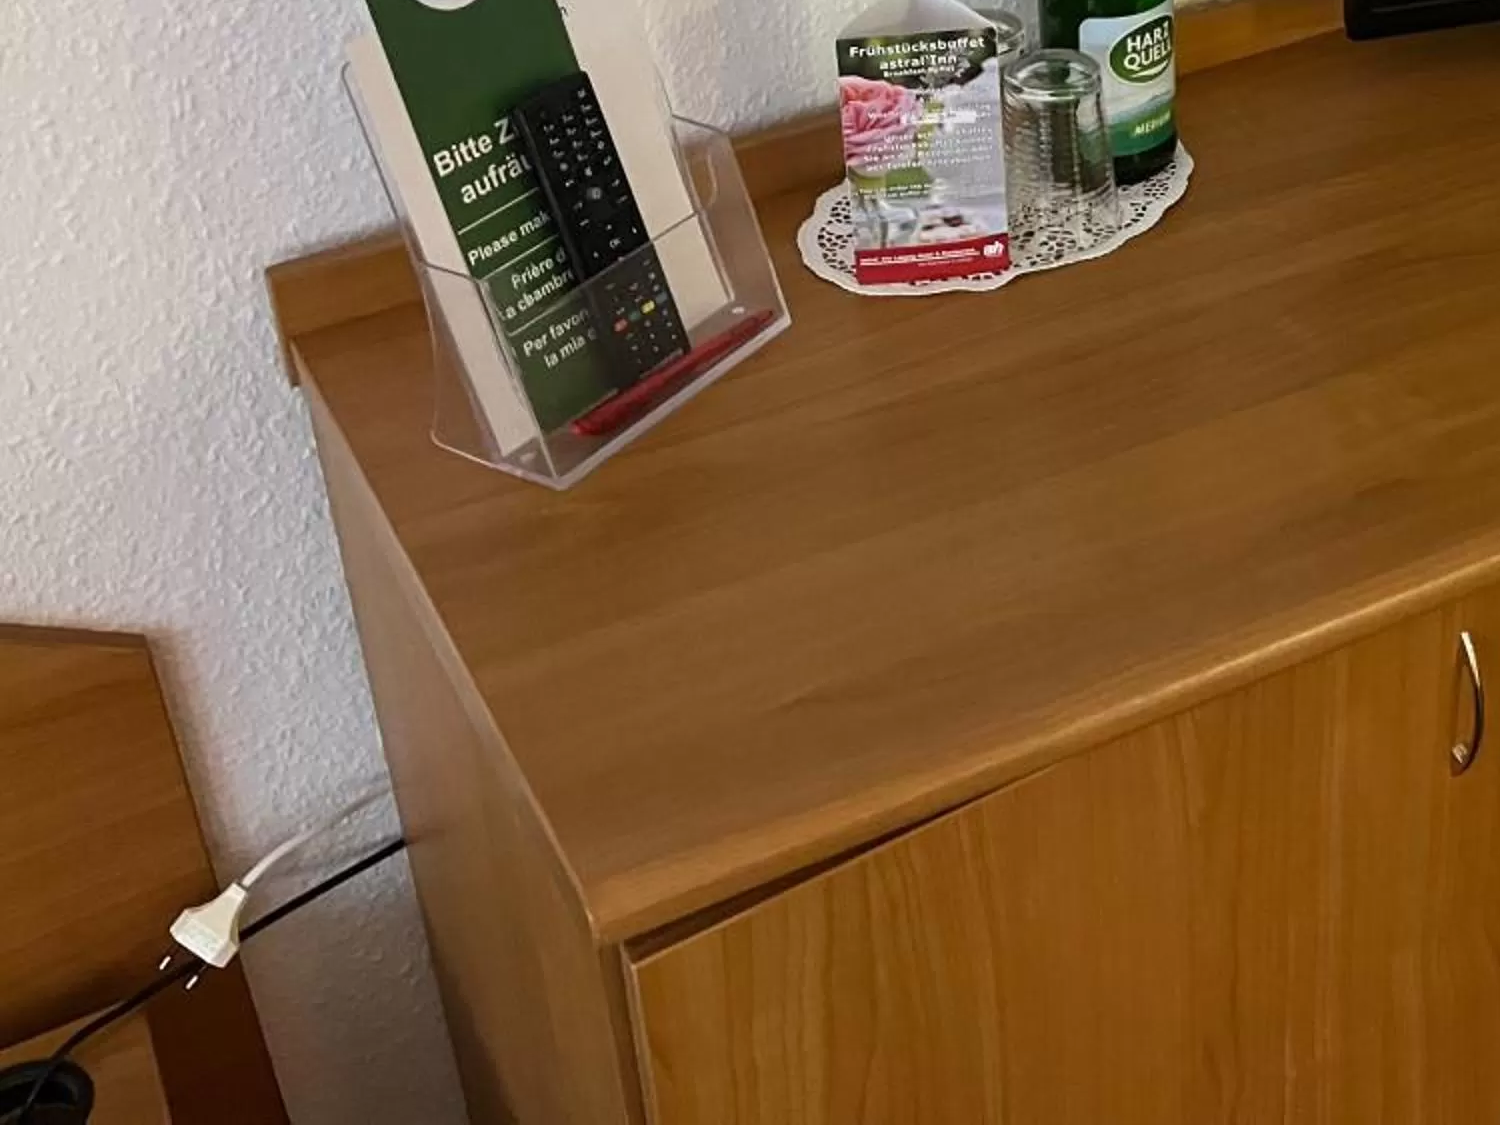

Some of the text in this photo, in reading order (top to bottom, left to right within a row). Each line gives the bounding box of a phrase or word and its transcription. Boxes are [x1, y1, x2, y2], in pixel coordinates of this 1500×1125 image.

[850, 36, 986, 58] Frühstücksbuffet
[433, 133, 494, 177] Bitte
[467, 229, 518, 266] Please
